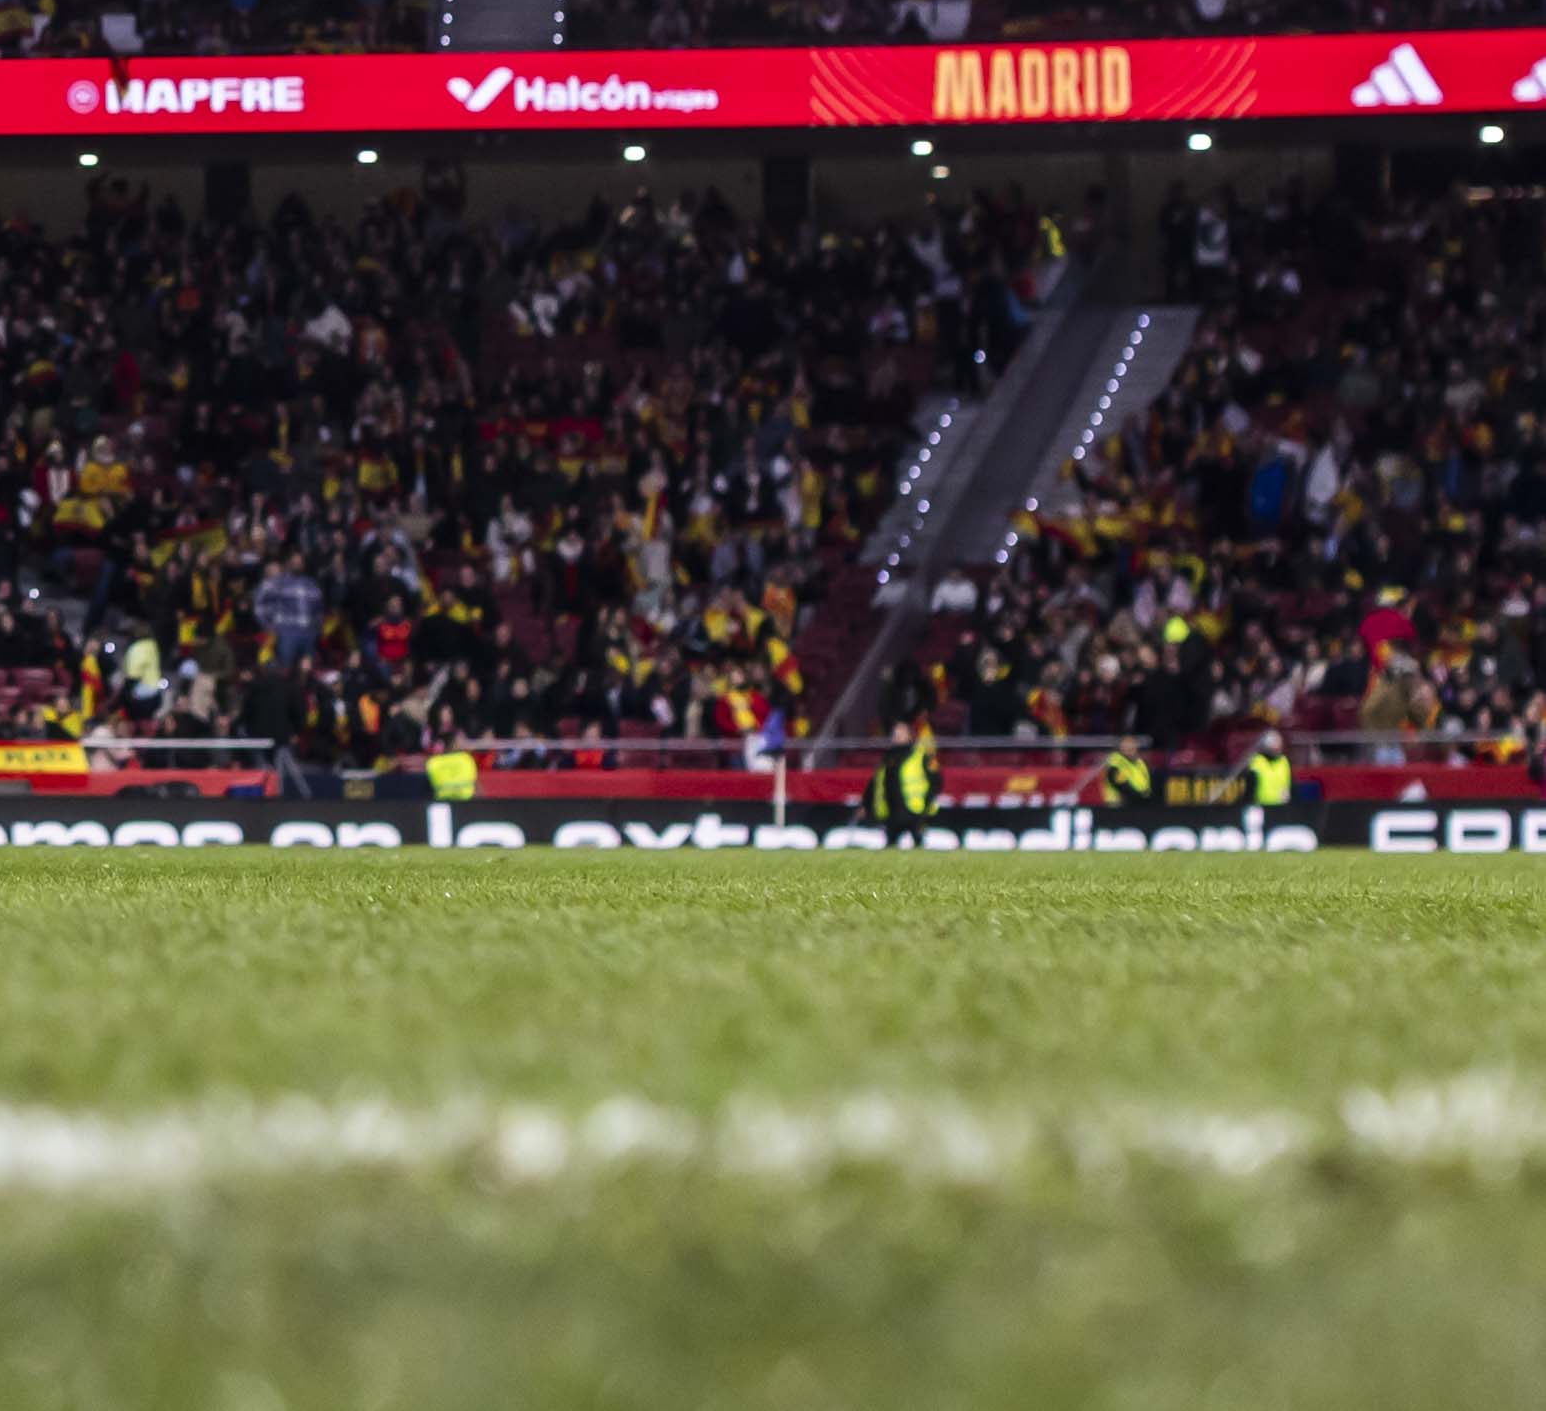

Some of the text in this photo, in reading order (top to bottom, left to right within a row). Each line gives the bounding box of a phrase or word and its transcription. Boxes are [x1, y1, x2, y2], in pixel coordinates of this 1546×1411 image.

[105, 76, 304, 114] MAPFRE
[515, 74, 650, 111] Halcón
[934, 47, 1131, 119] MADRID
